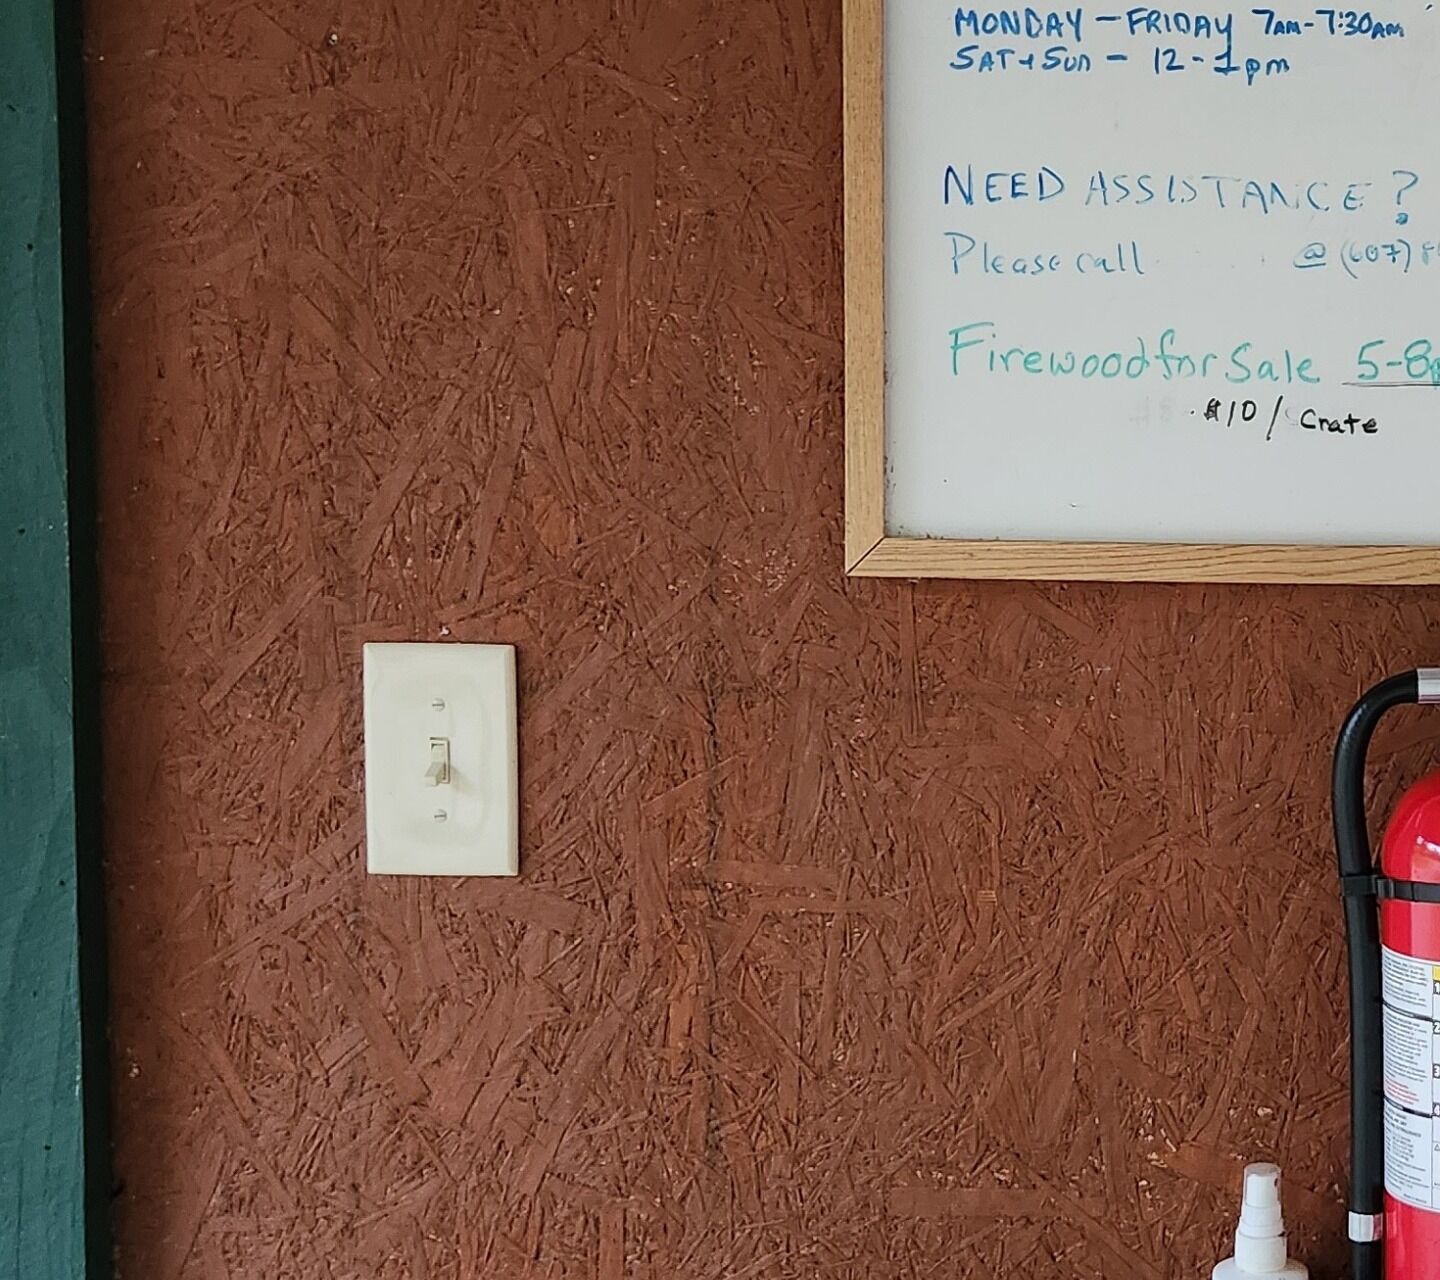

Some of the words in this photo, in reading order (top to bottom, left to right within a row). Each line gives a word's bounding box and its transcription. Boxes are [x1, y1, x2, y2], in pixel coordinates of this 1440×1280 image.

[954, 7, 1082, 42] MONDAY
[1127, 7, 1232, 42] FRIDAY
[943, 164, 1065, 206] NEED
[944, 231, 1061, 276] Please
[1077, 241, 1145, 276] call
[949, 321, 1152, 382] Firewood
[1158, 329, 1215, 382] for
[1228, 342, 1321, 384] Sale
[1300, 409, 1379, 435] Crate
